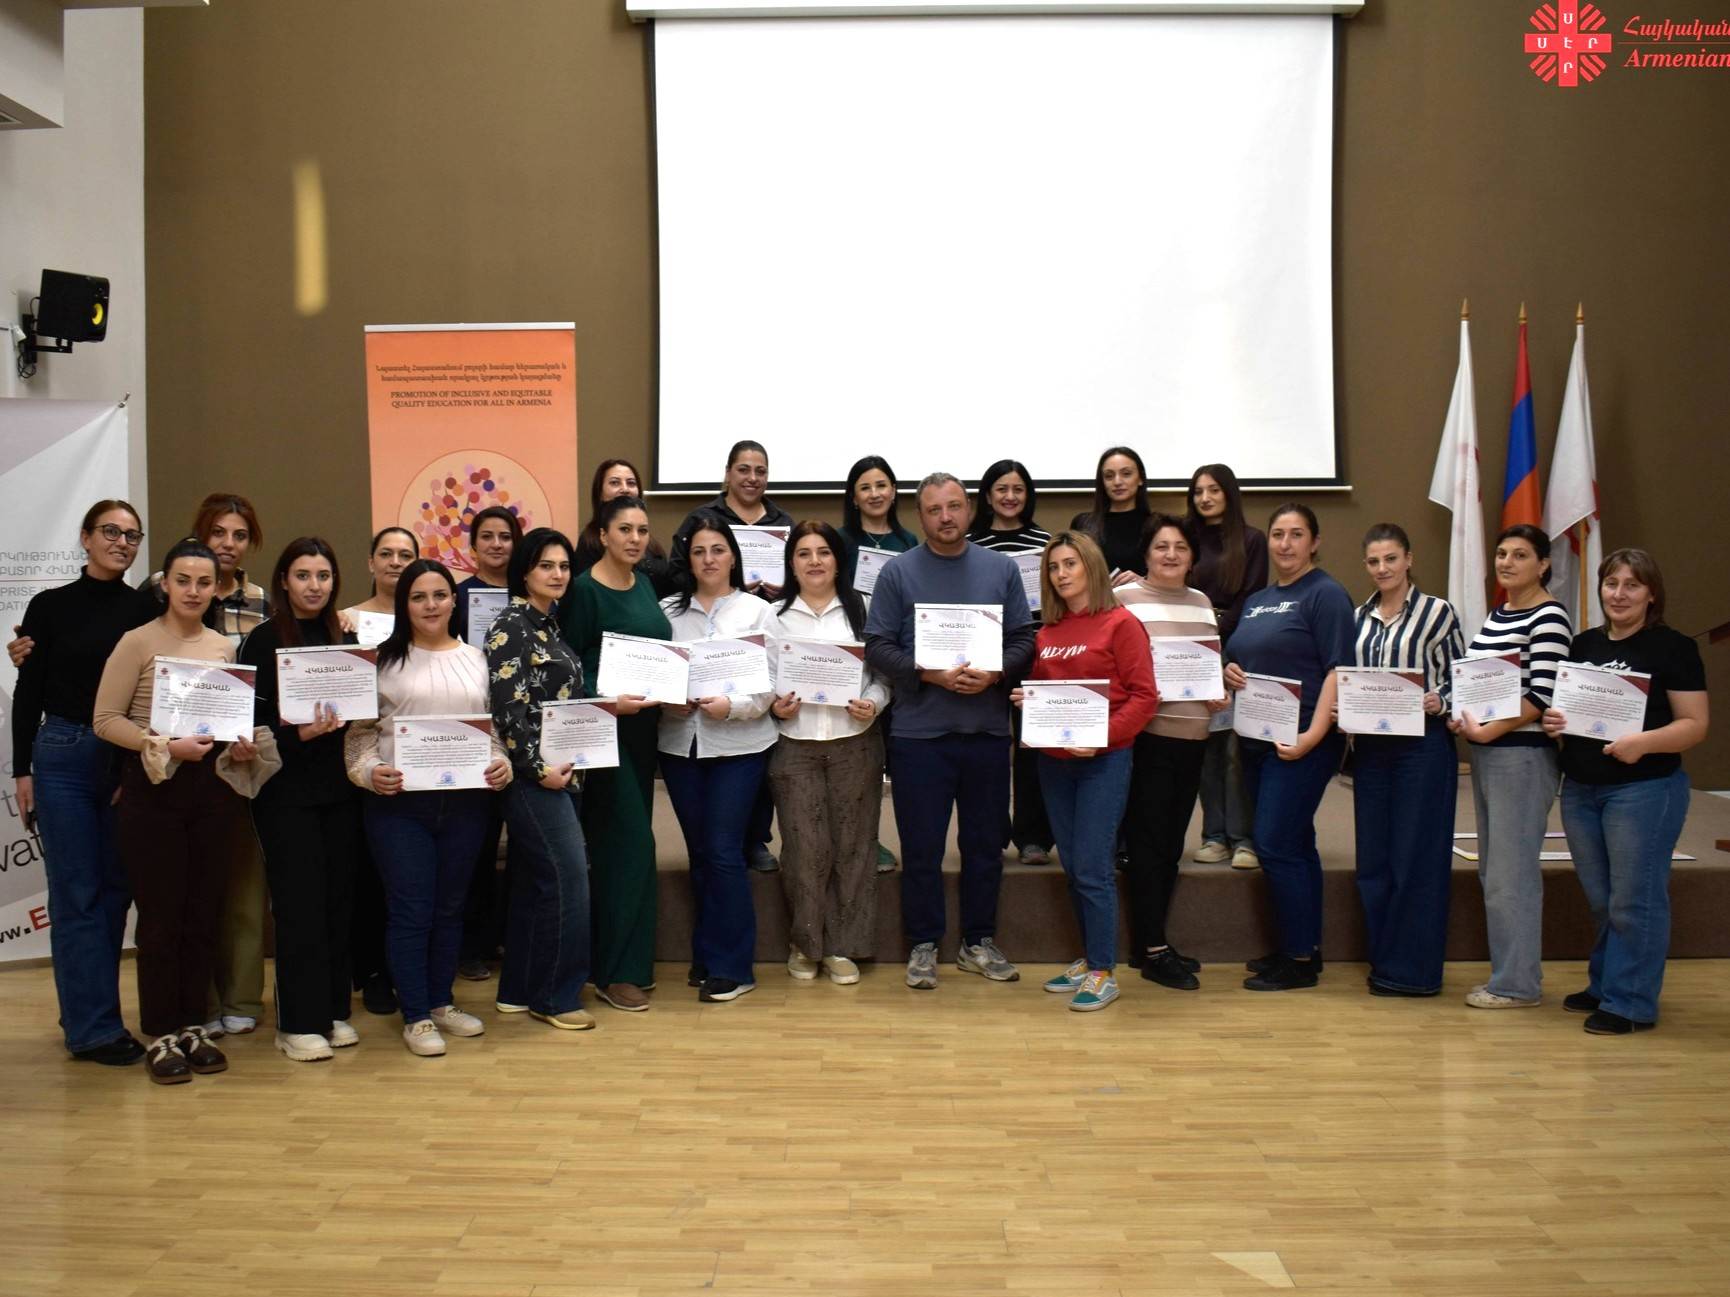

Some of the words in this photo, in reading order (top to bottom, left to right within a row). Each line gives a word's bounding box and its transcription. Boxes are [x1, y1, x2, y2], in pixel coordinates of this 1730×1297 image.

[510, 389, 552, 398] EQUITABLE
[392, 400, 425, 408] QUALITY
[0, 586, 37, 597] PRISE
